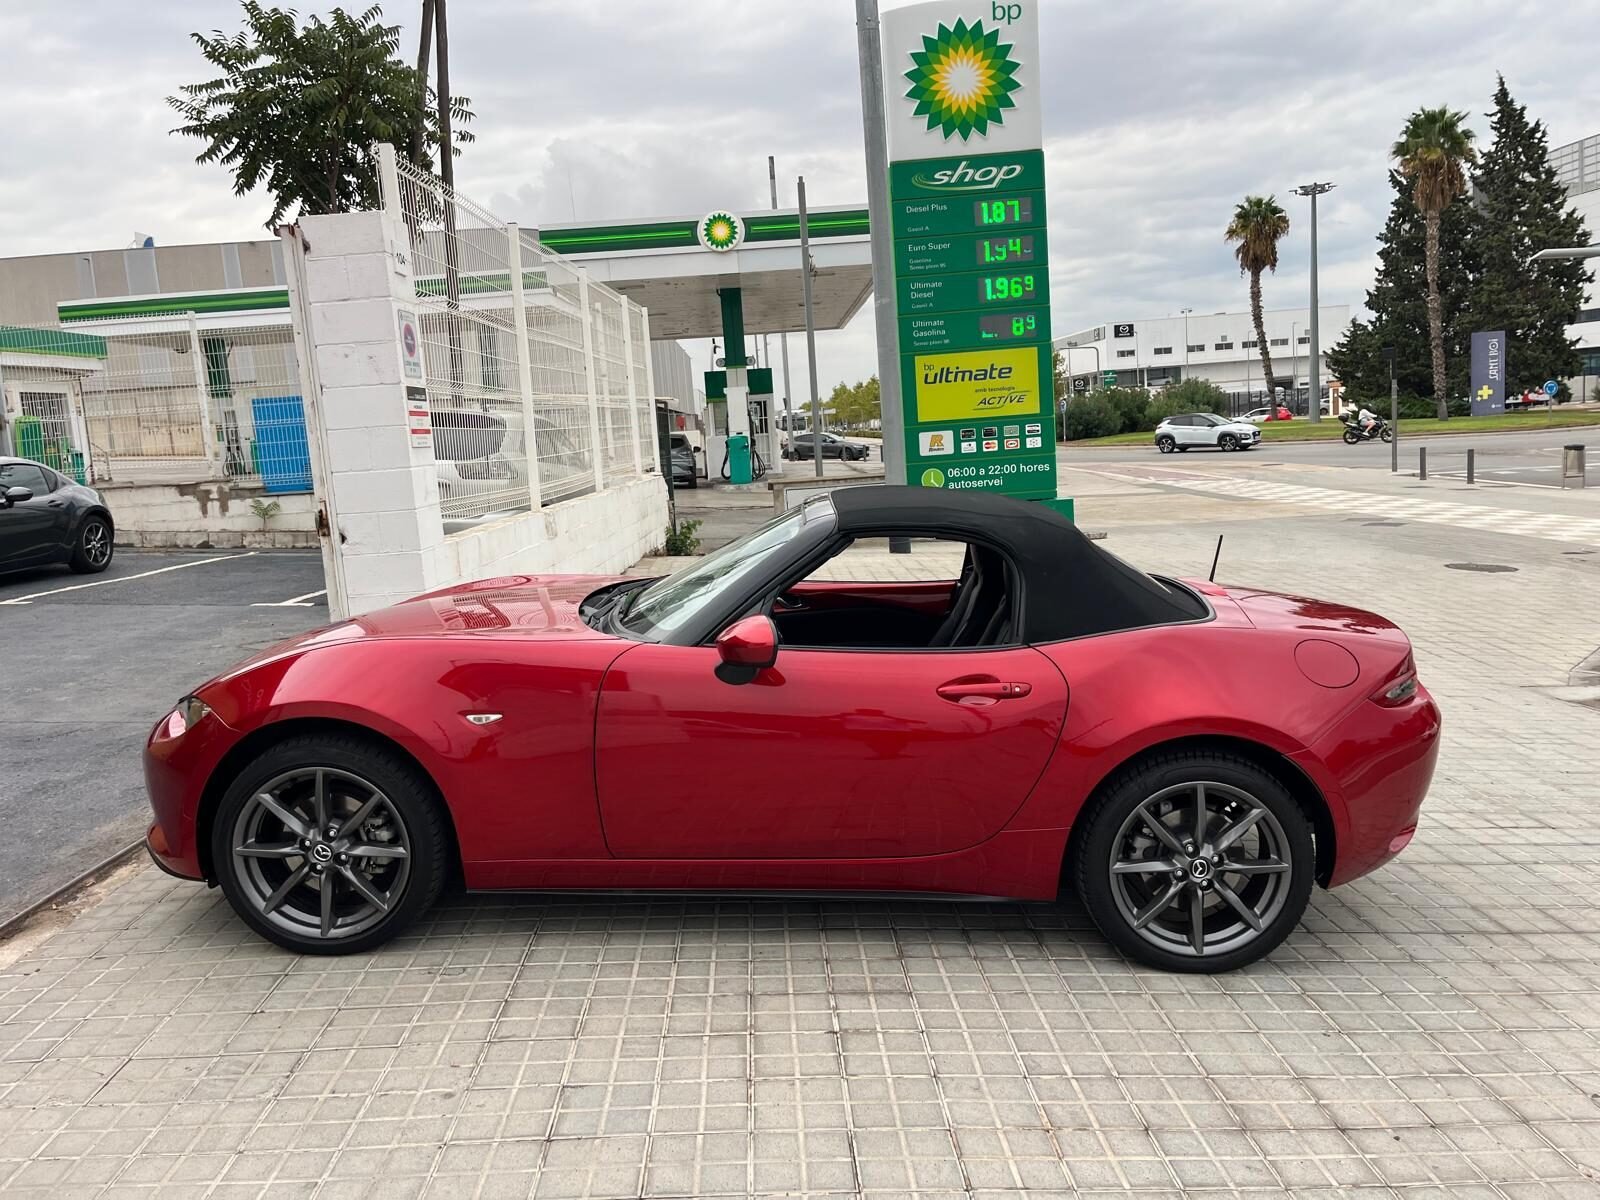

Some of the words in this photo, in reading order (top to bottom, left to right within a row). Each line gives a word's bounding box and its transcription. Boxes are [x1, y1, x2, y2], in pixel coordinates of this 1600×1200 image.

[992, 1, 1022, 25] bp
[932, 160, 1023, 188] shop
[906, 204, 930, 214] Diesel
[931, 203, 948, 212] Plus
[908, 244, 927, 252] Euro
[928, 242, 951, 251] Super
[910, 281, 943, 290] Ultimate
[910, 290, 934, 299] Diesel
[912, 320, 945, 328] Ultimate
[913, 329, 946, 337] Gasolina
[924, 363, 935, 371] bp
[923, 363, 1013, 385] ultimate
[976, 393, 1027, 407] ACTIVE
[947, 466, 976, 478] 06:00
[979, 467, 986, 476] a
[988, 463, 1017, 475] 22:00
[1020, 463, 1050, 473] hores
[948, 476, 1003, 489] autoservei
